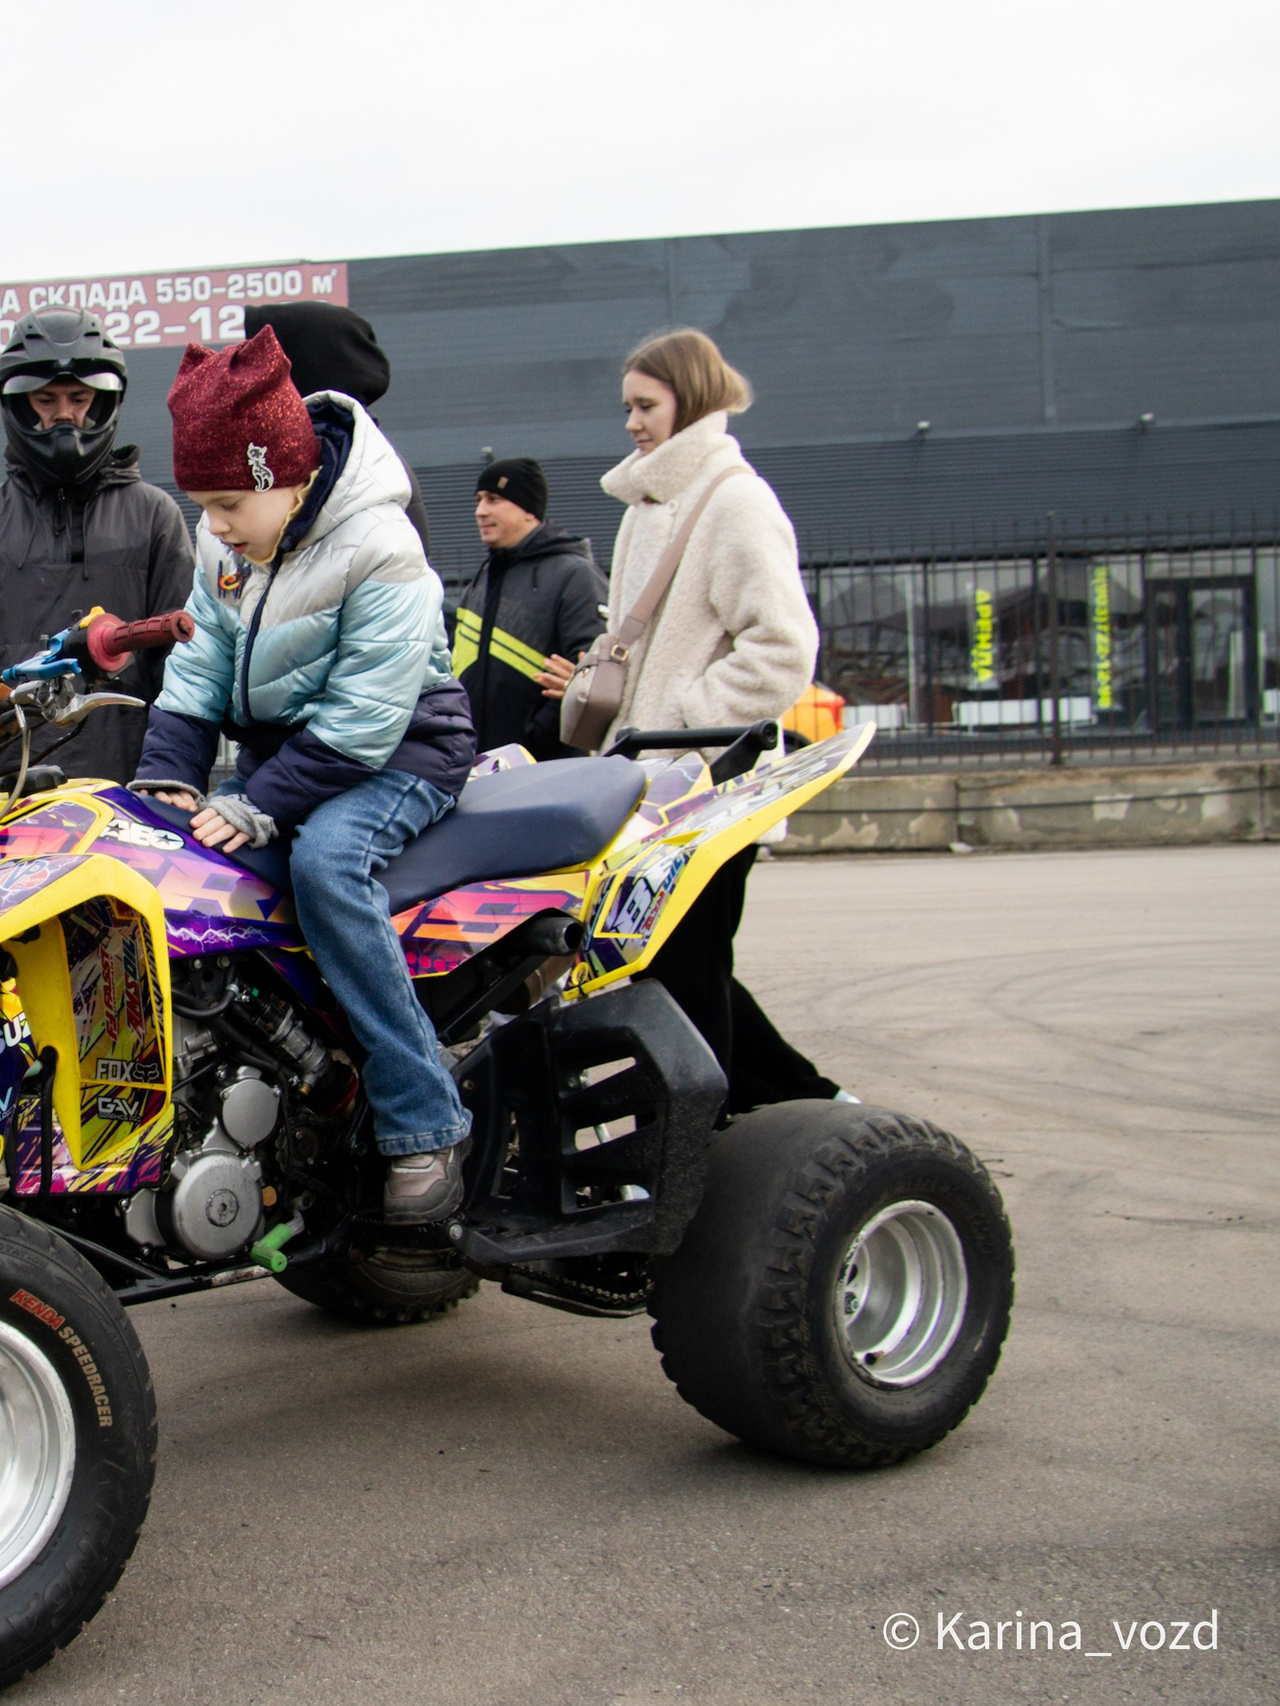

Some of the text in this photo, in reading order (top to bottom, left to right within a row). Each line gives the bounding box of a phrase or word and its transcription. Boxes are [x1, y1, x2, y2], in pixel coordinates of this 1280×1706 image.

[28, 279, 147, 311] СКЛАДА
[156, 269, 303, 301] 550-2500
[121, 935, 145, 1046] AMSOIL
[96, 1058, 134, 1082] FOX
[97, 1097, 141, 1116] GAV
[9, 1288, 113, 1427] KENDA SPEEDRACER
